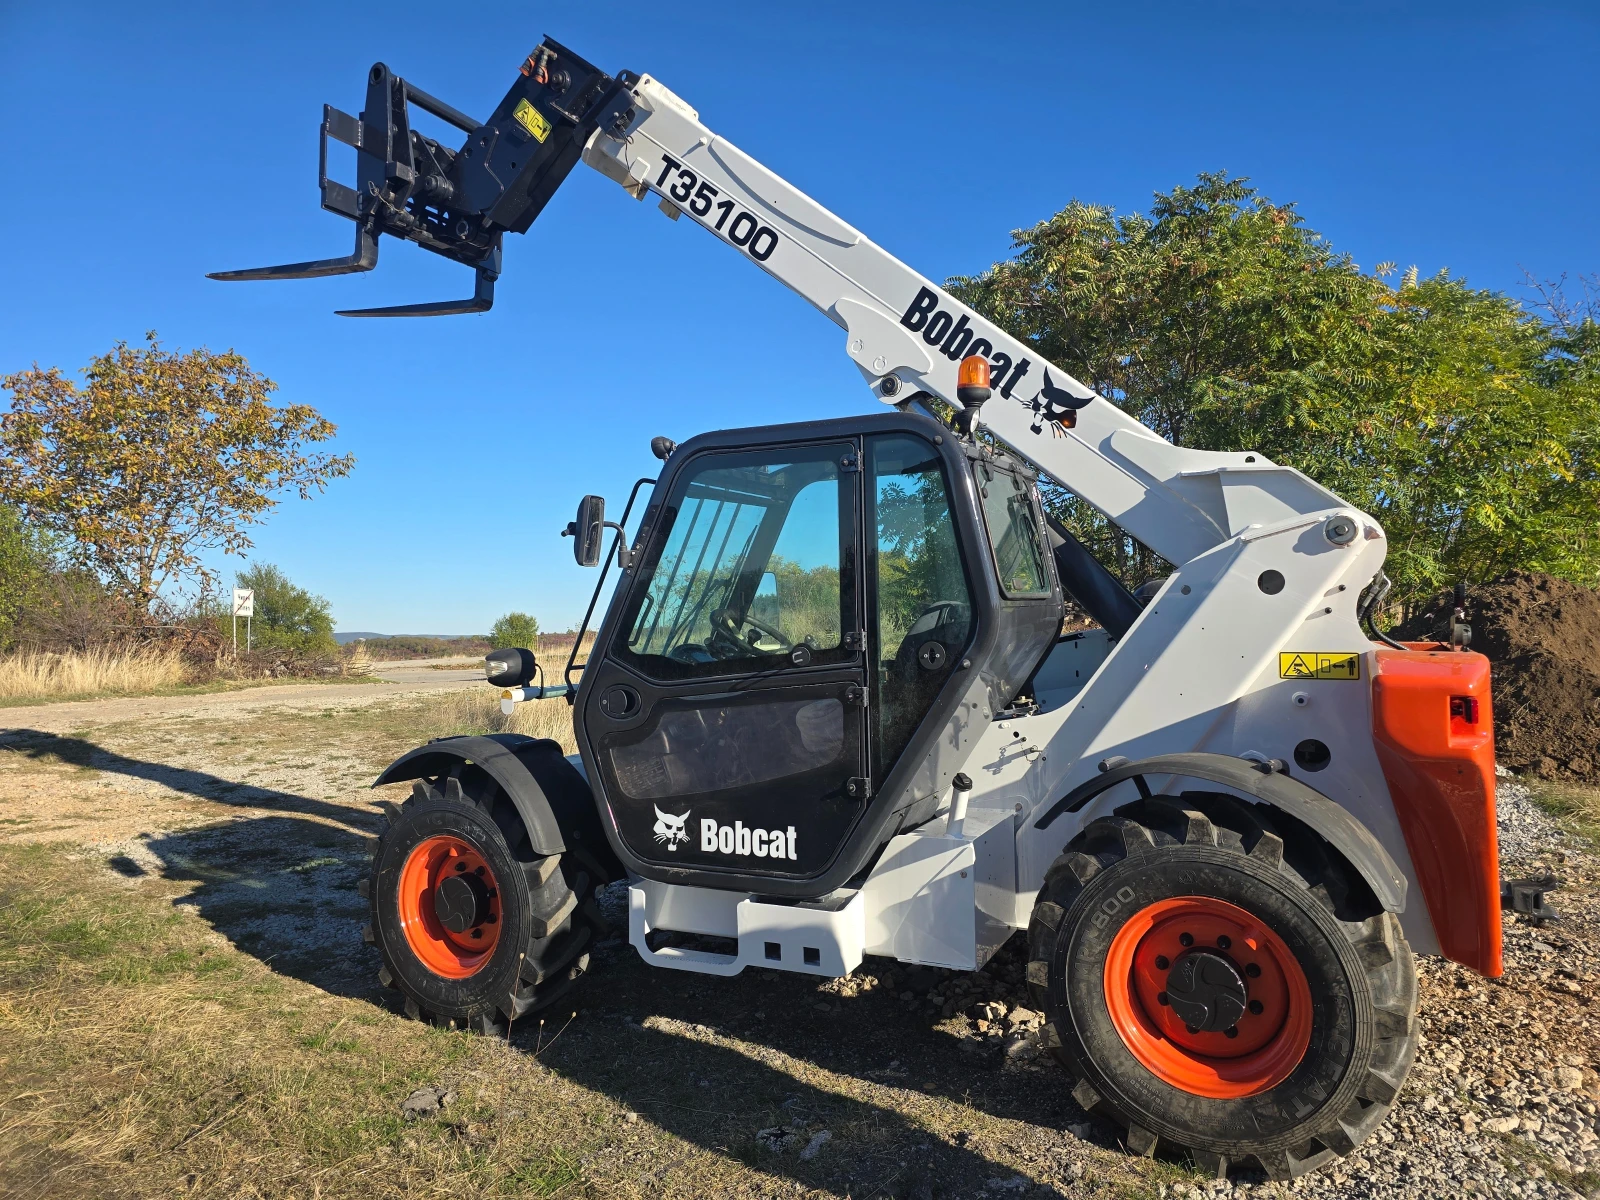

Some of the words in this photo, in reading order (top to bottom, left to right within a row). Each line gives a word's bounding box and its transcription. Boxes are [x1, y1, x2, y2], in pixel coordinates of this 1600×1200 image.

[654, 154, 780, 262] T35100
[899, 285, 1032, 401] Bobcat
[700, 817, 798, 861] Bobcat
[1090, 885, 1136, 930] 800
[1290, 1035, 1350, 1118] CEAT
